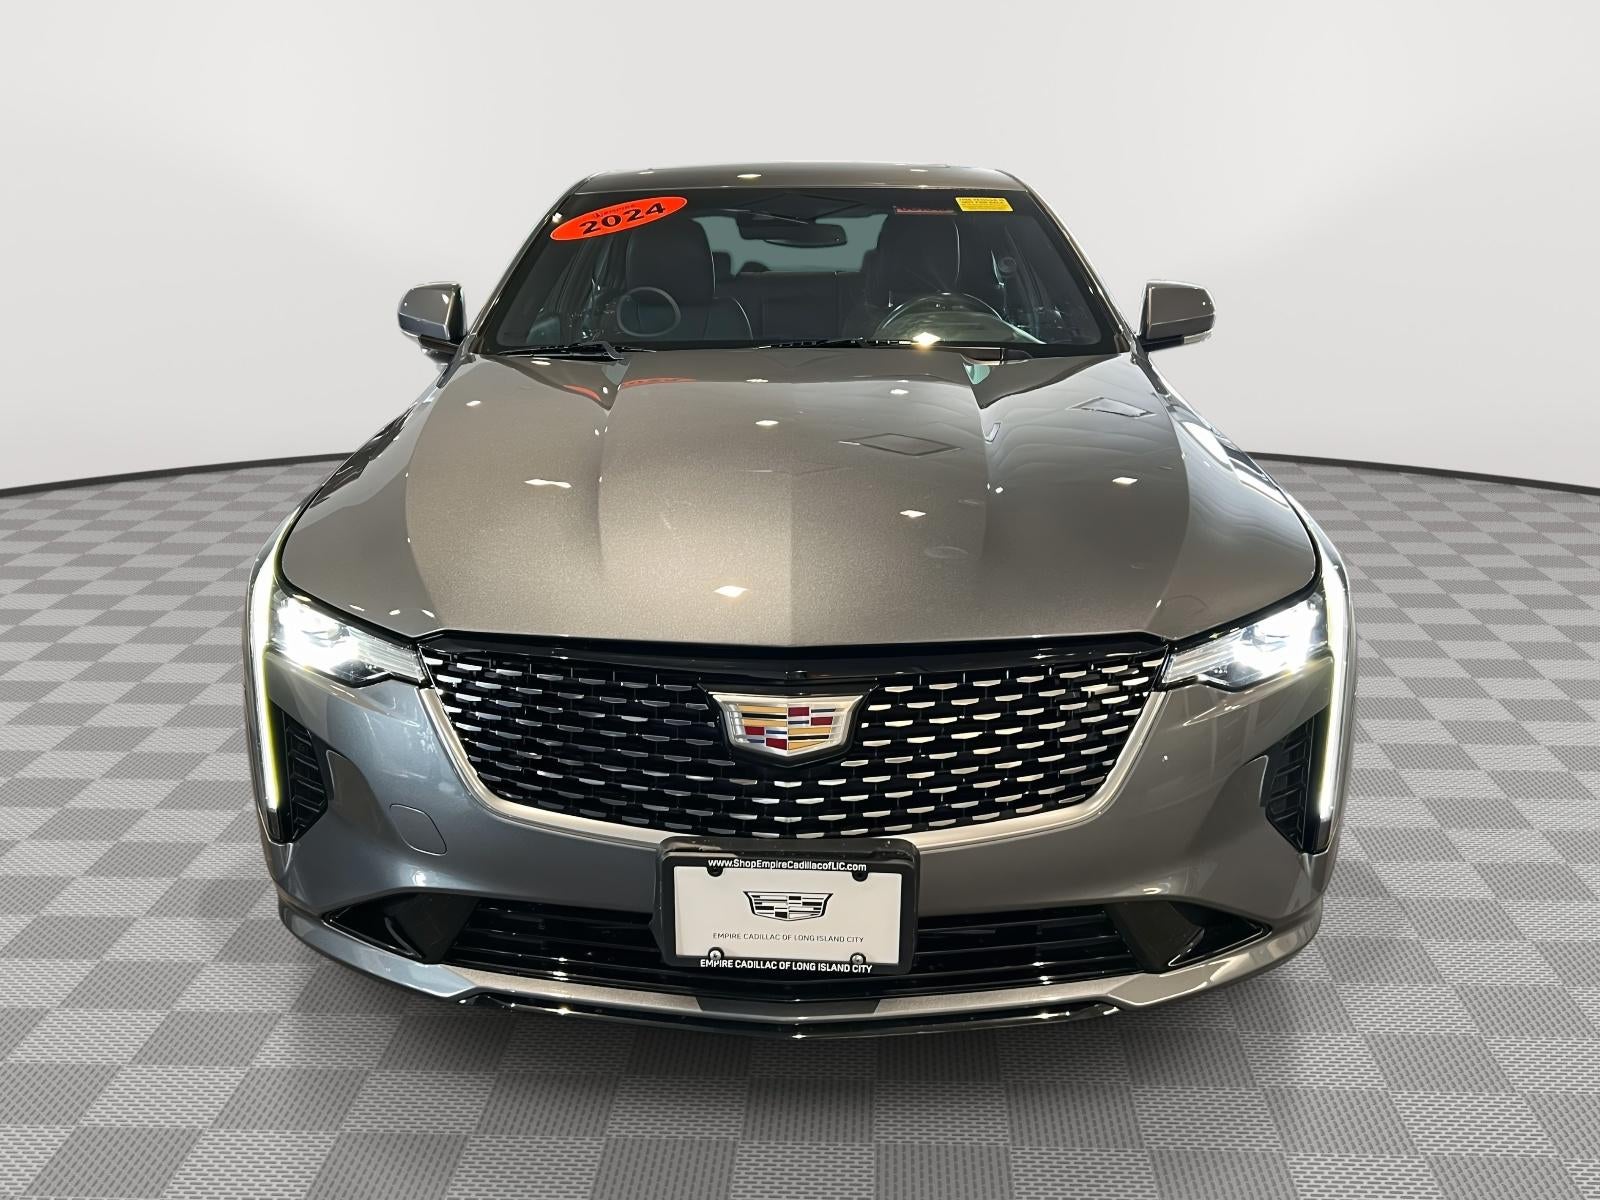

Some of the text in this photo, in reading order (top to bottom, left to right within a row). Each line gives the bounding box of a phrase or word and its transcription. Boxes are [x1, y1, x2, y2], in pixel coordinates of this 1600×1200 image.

[579, 202, 665, 235] 2024
[707, 858, 867, 872] www.ShopEmpireCadillacofLIC.com
[712, 932, 742, 940] EMPIRE
[743, 933, 781, 941] CADILLAC
[794, 934, 815, 942] LONG
[816, 935, 845, 943] ISLAND
[700, 959, 873, 974] EMPIRE CADILLAC OF LONG ISLAND CITY
